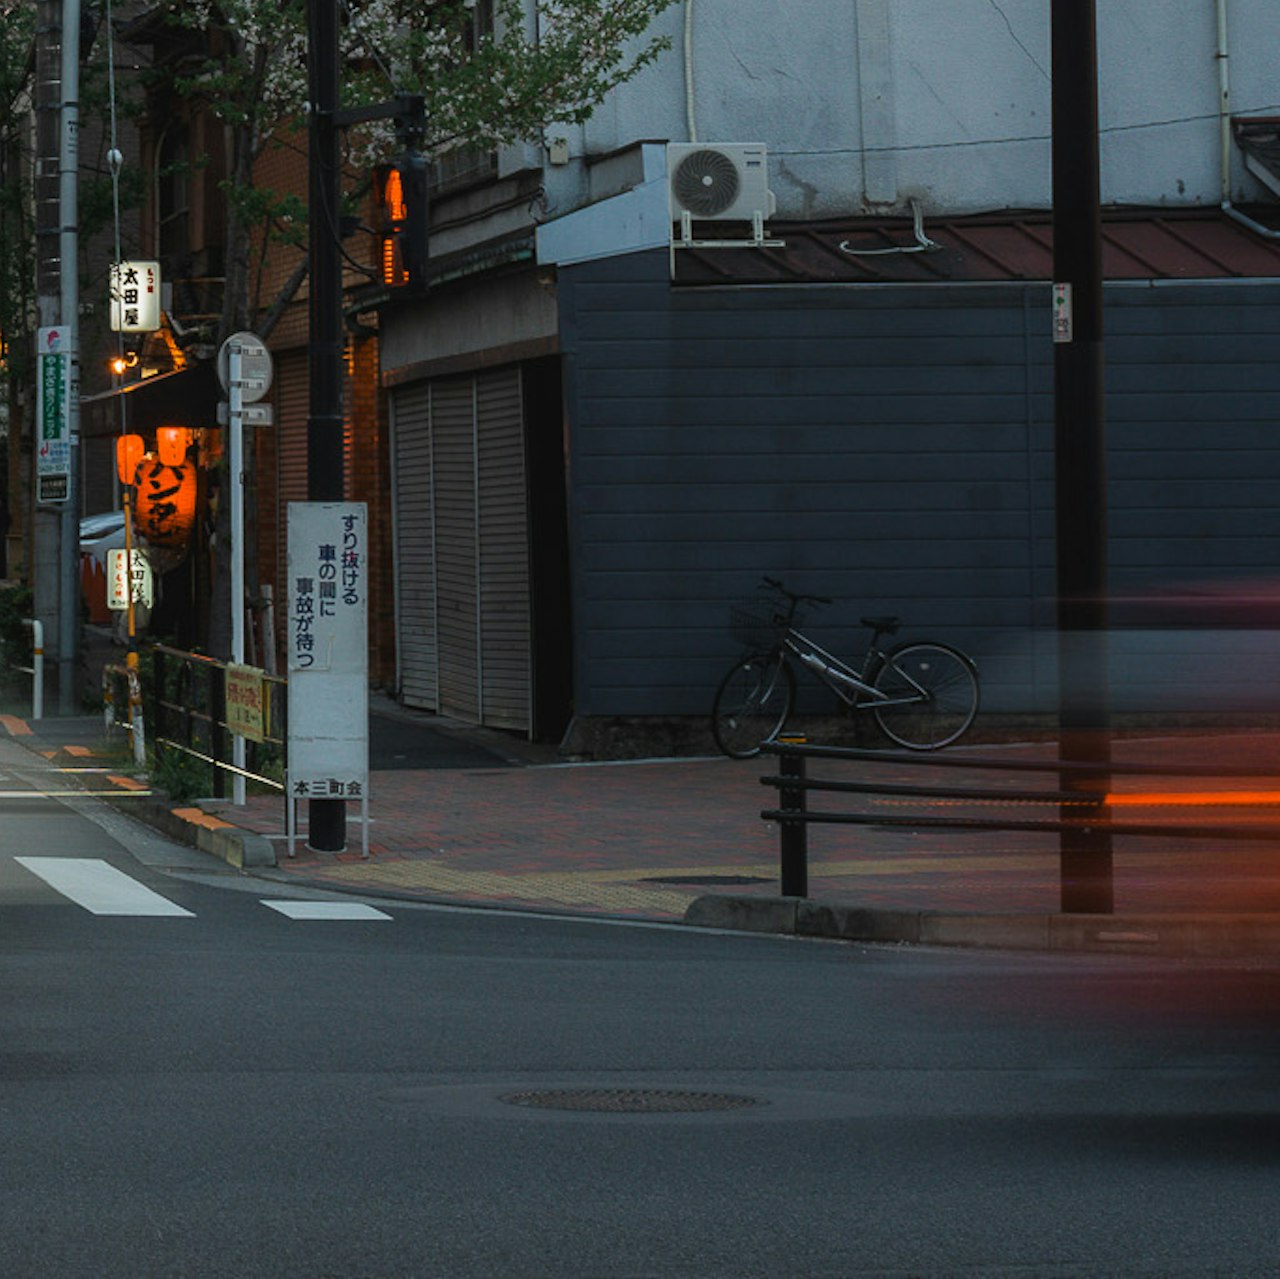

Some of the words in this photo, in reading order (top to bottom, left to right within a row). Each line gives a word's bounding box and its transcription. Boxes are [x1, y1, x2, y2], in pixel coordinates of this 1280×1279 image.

[123, 268, 139, 325] 太田屋
[318, 543, 337, 617] 車の間に
[341, 514, 359, 606] すり抜ける
[295, 577, 315, 668] 事故が待つ
[293, 779, 363, 796] 本三町会
